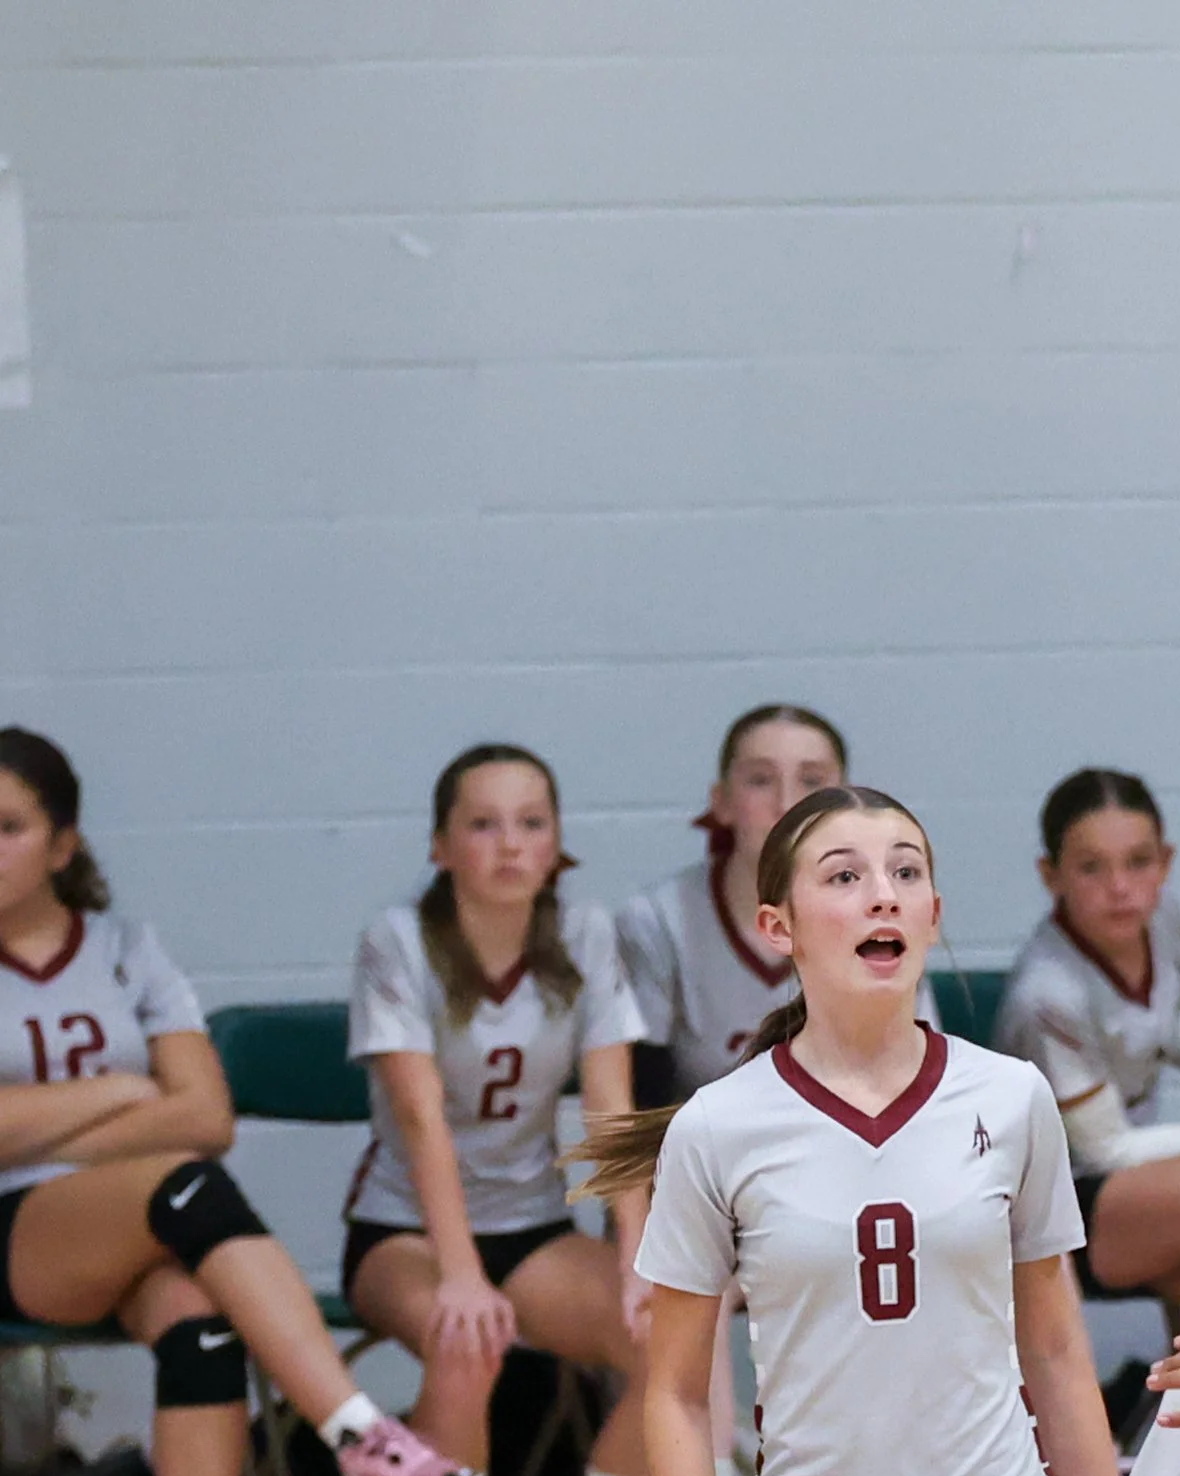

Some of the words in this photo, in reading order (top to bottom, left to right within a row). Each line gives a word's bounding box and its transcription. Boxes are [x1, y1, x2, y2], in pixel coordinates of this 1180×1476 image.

[24, 1012, 106, 1083] 12
[480, 1046, 522, 1119] 2
[854, 1199, 919, 1325] 8
